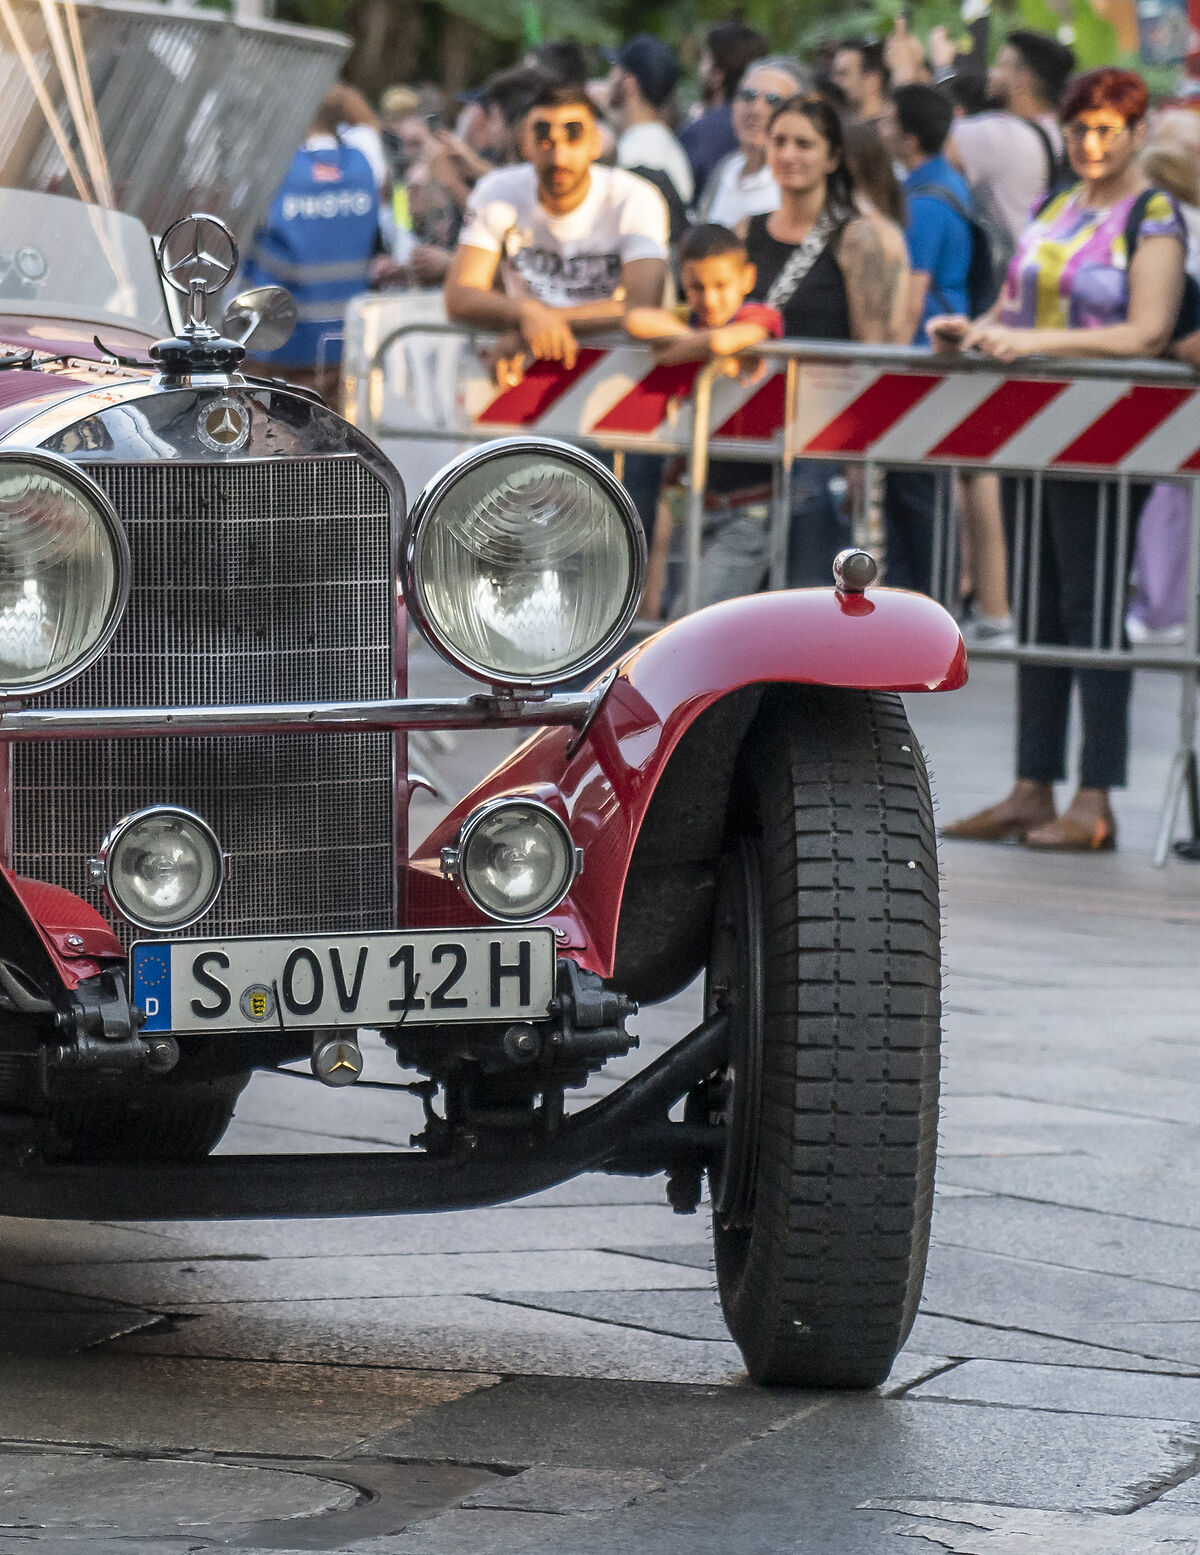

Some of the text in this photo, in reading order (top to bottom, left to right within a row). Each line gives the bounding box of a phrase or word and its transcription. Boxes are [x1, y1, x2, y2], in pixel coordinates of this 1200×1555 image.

[282, 193, 372, 220] PHOTO
[191, 951, 231, 1018] S
[283, 946, 369, 1015] OV
[146, 998, 159, 1017] D
